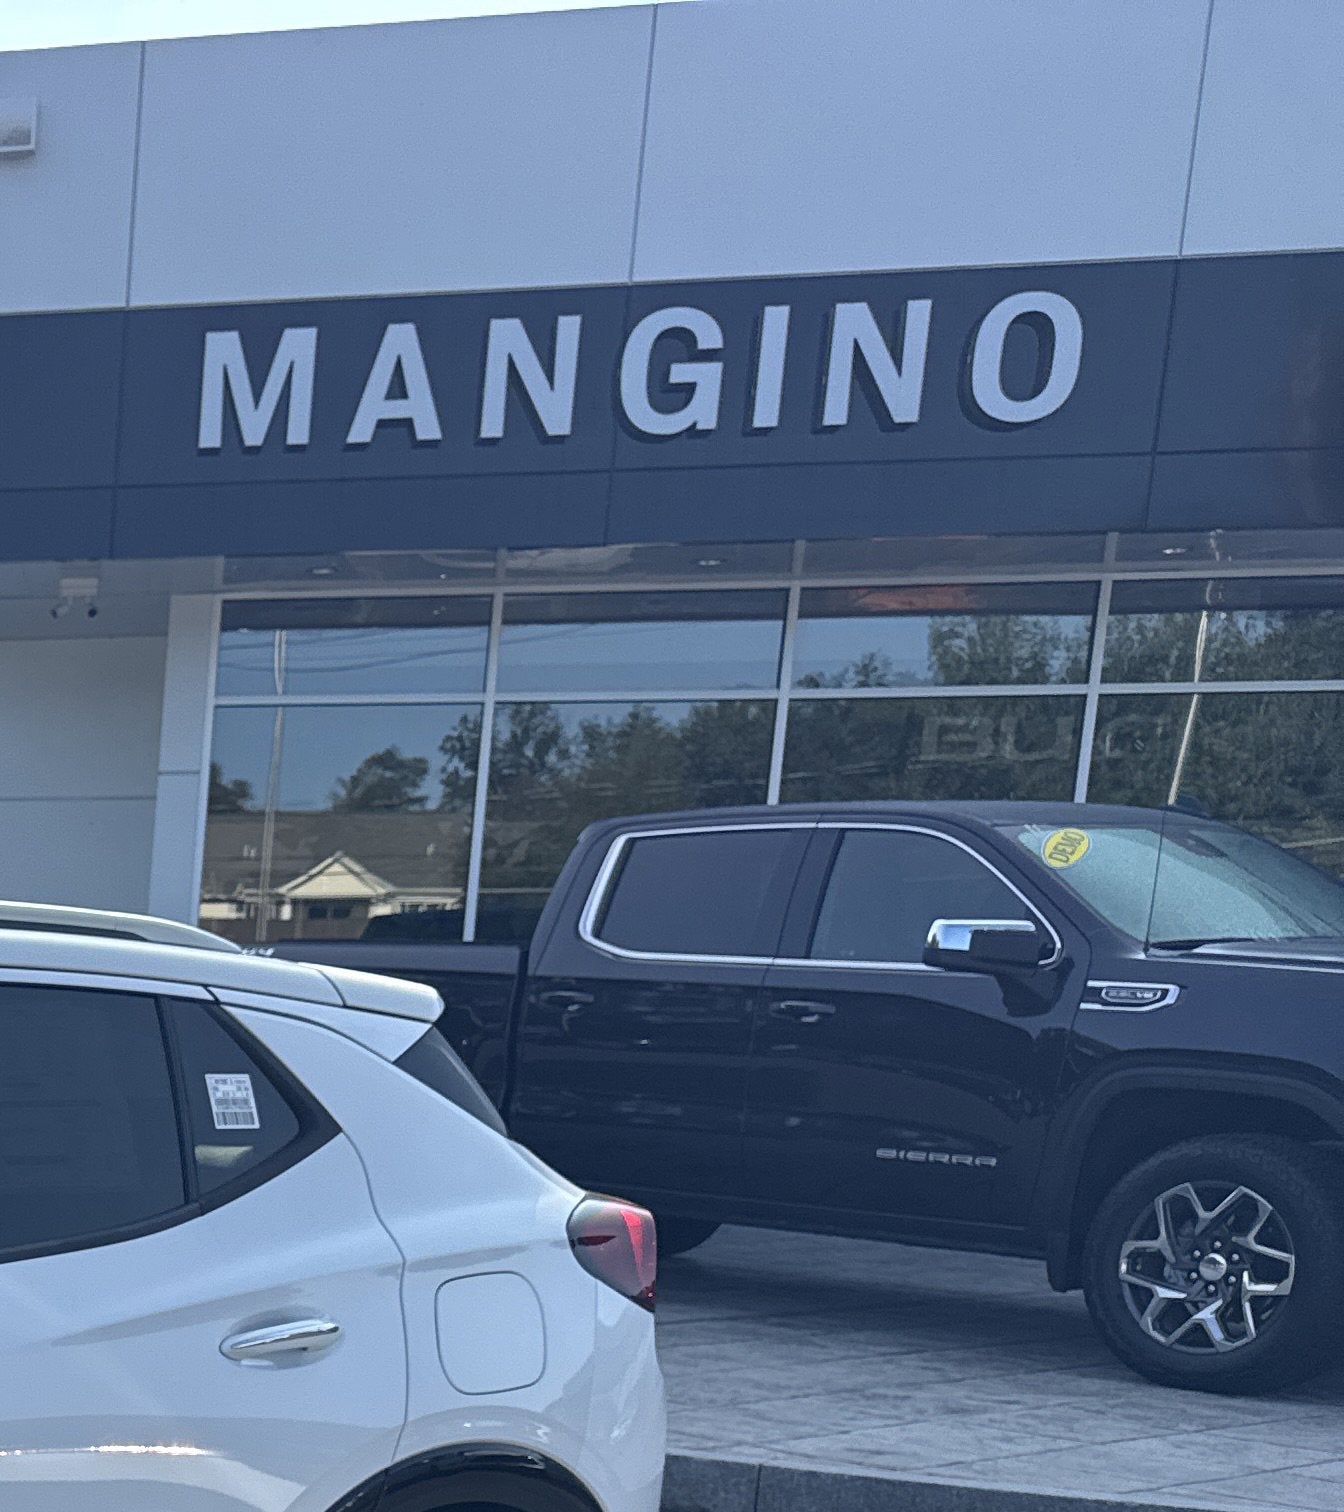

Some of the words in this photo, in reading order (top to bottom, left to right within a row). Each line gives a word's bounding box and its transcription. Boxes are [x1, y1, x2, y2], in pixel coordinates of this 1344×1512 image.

[196, 290, 1085, 450] MANGINO
[1048, 831, 1085, 864] DEMO
[876, 1147, 997, 1167] SIERRA
